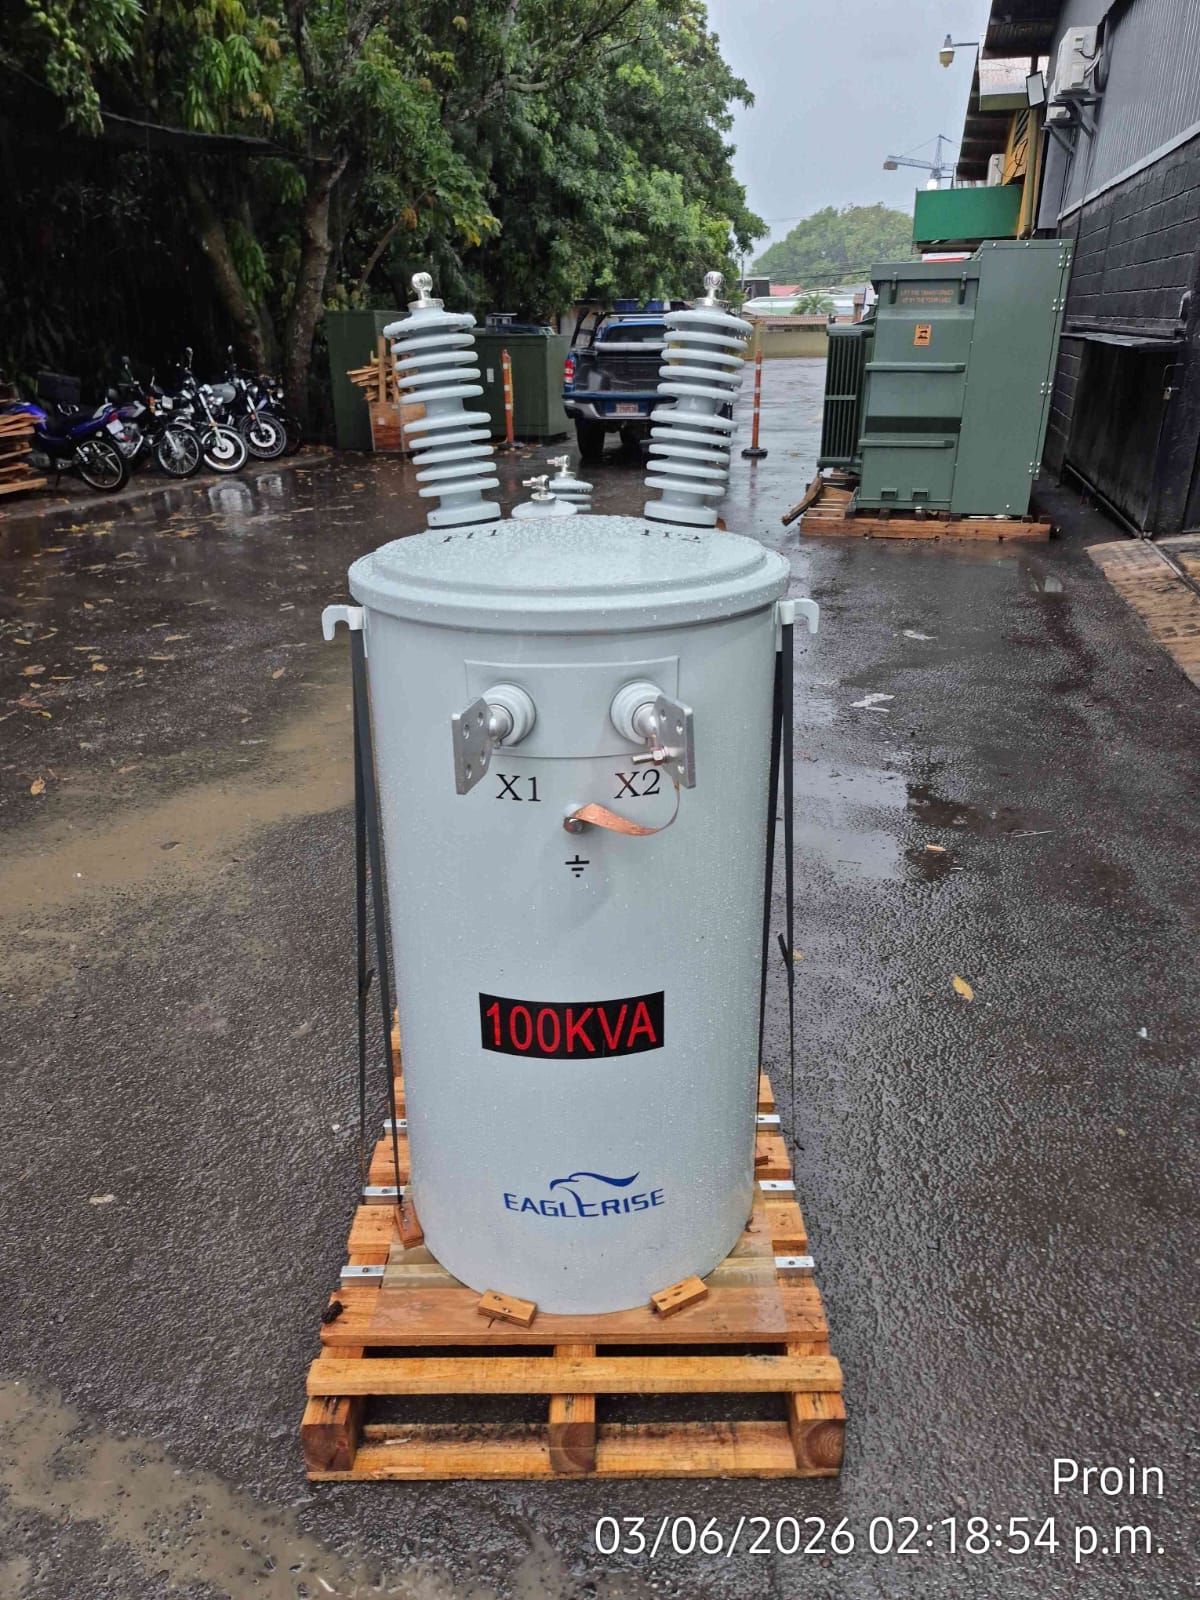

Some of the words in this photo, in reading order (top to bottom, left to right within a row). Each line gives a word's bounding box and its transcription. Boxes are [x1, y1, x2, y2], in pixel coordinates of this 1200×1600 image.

[496, 773, 541, 802] X1
[614, 768, 662, 799] X2
[486, 1001, 657, 1053] 100KVA
[503, 1187, 666, 1218] EAGLERISE
